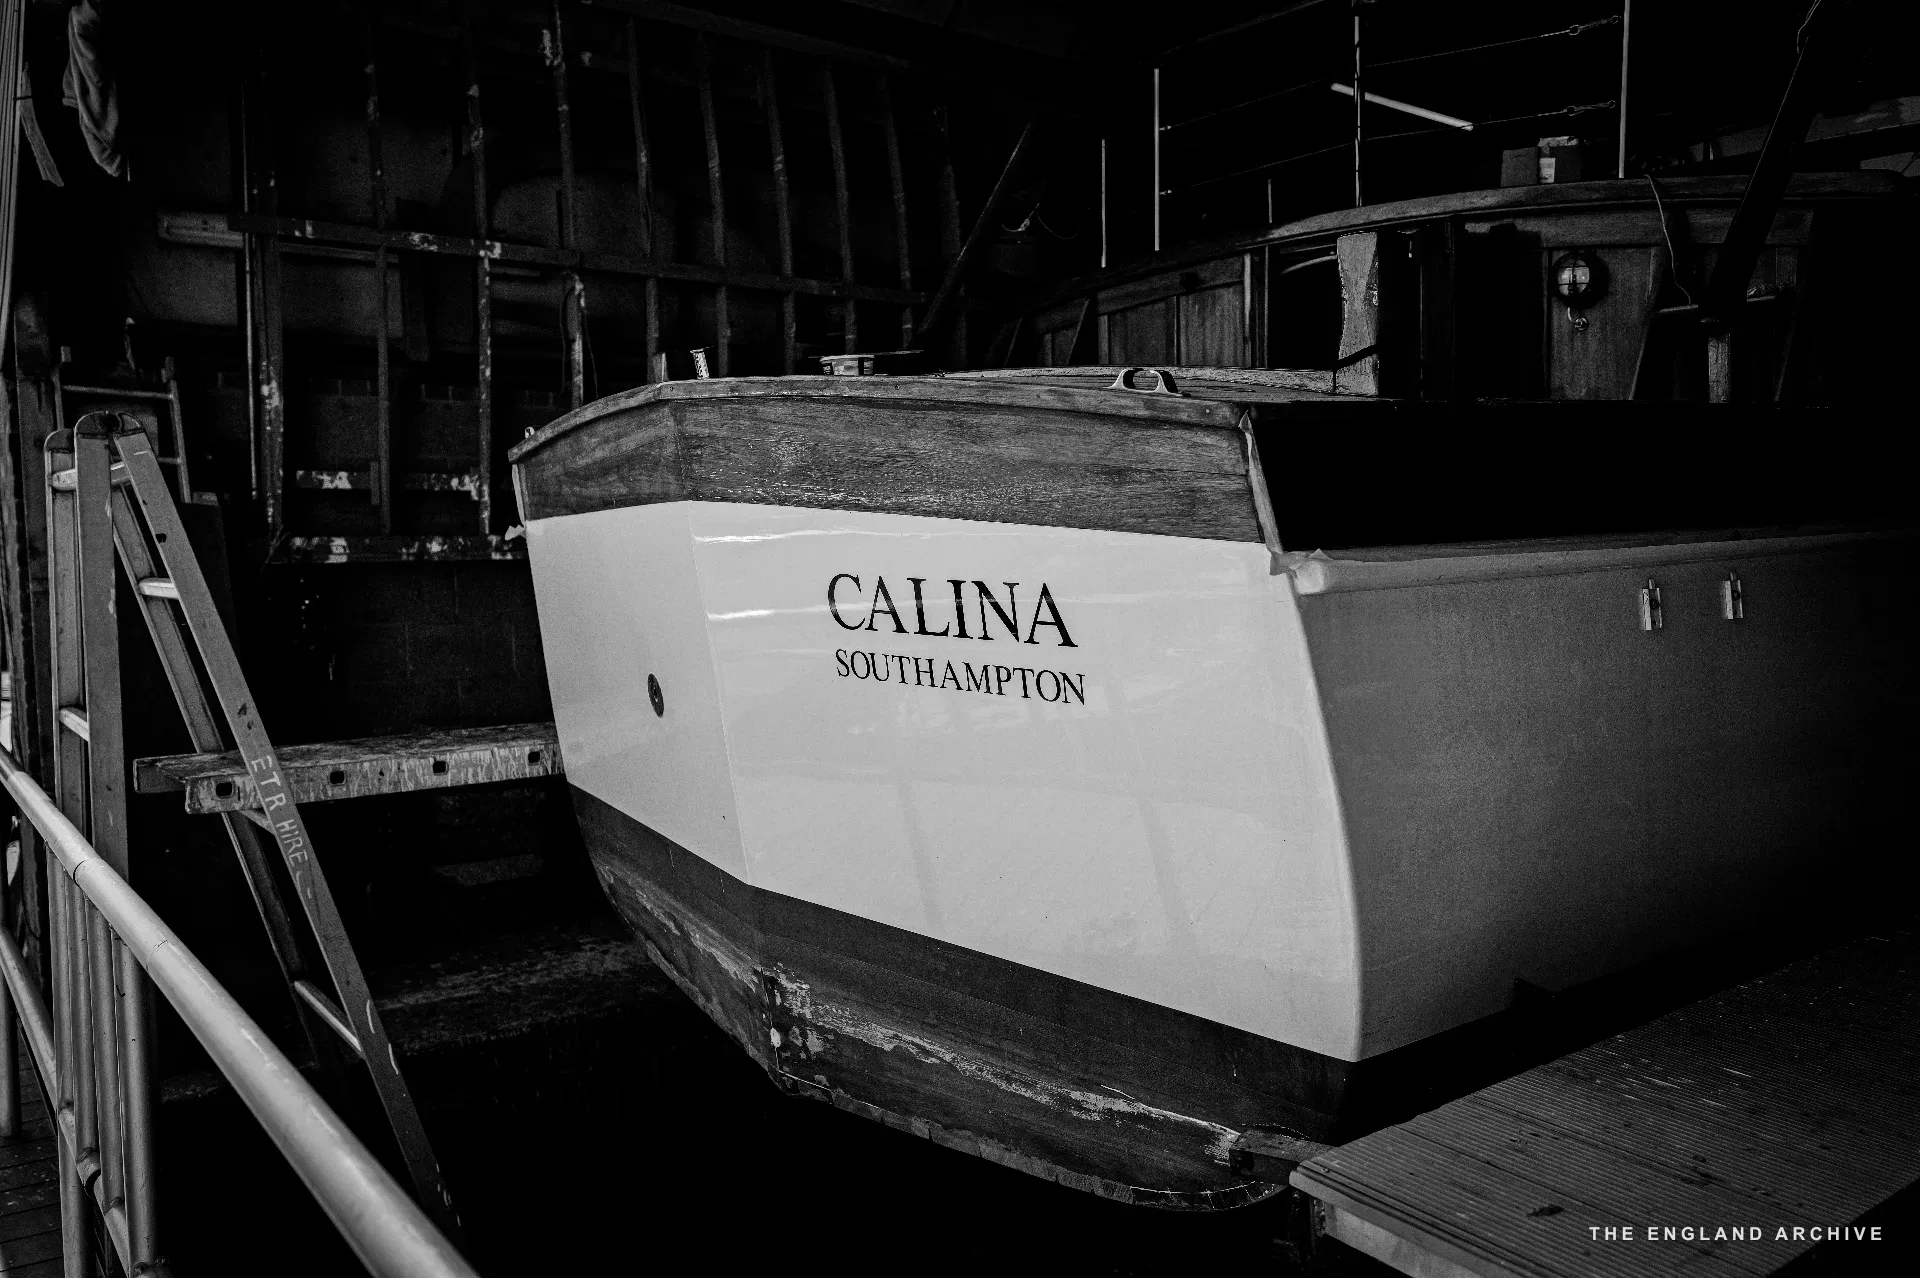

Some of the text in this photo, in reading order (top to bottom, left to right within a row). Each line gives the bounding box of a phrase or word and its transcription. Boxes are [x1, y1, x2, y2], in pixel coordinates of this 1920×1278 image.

[828, 573, 1078, 647] CALINA
[835, 649, 1086, 705] SOUTHAMPTON
[275, 818, 308, 867] HIRE
